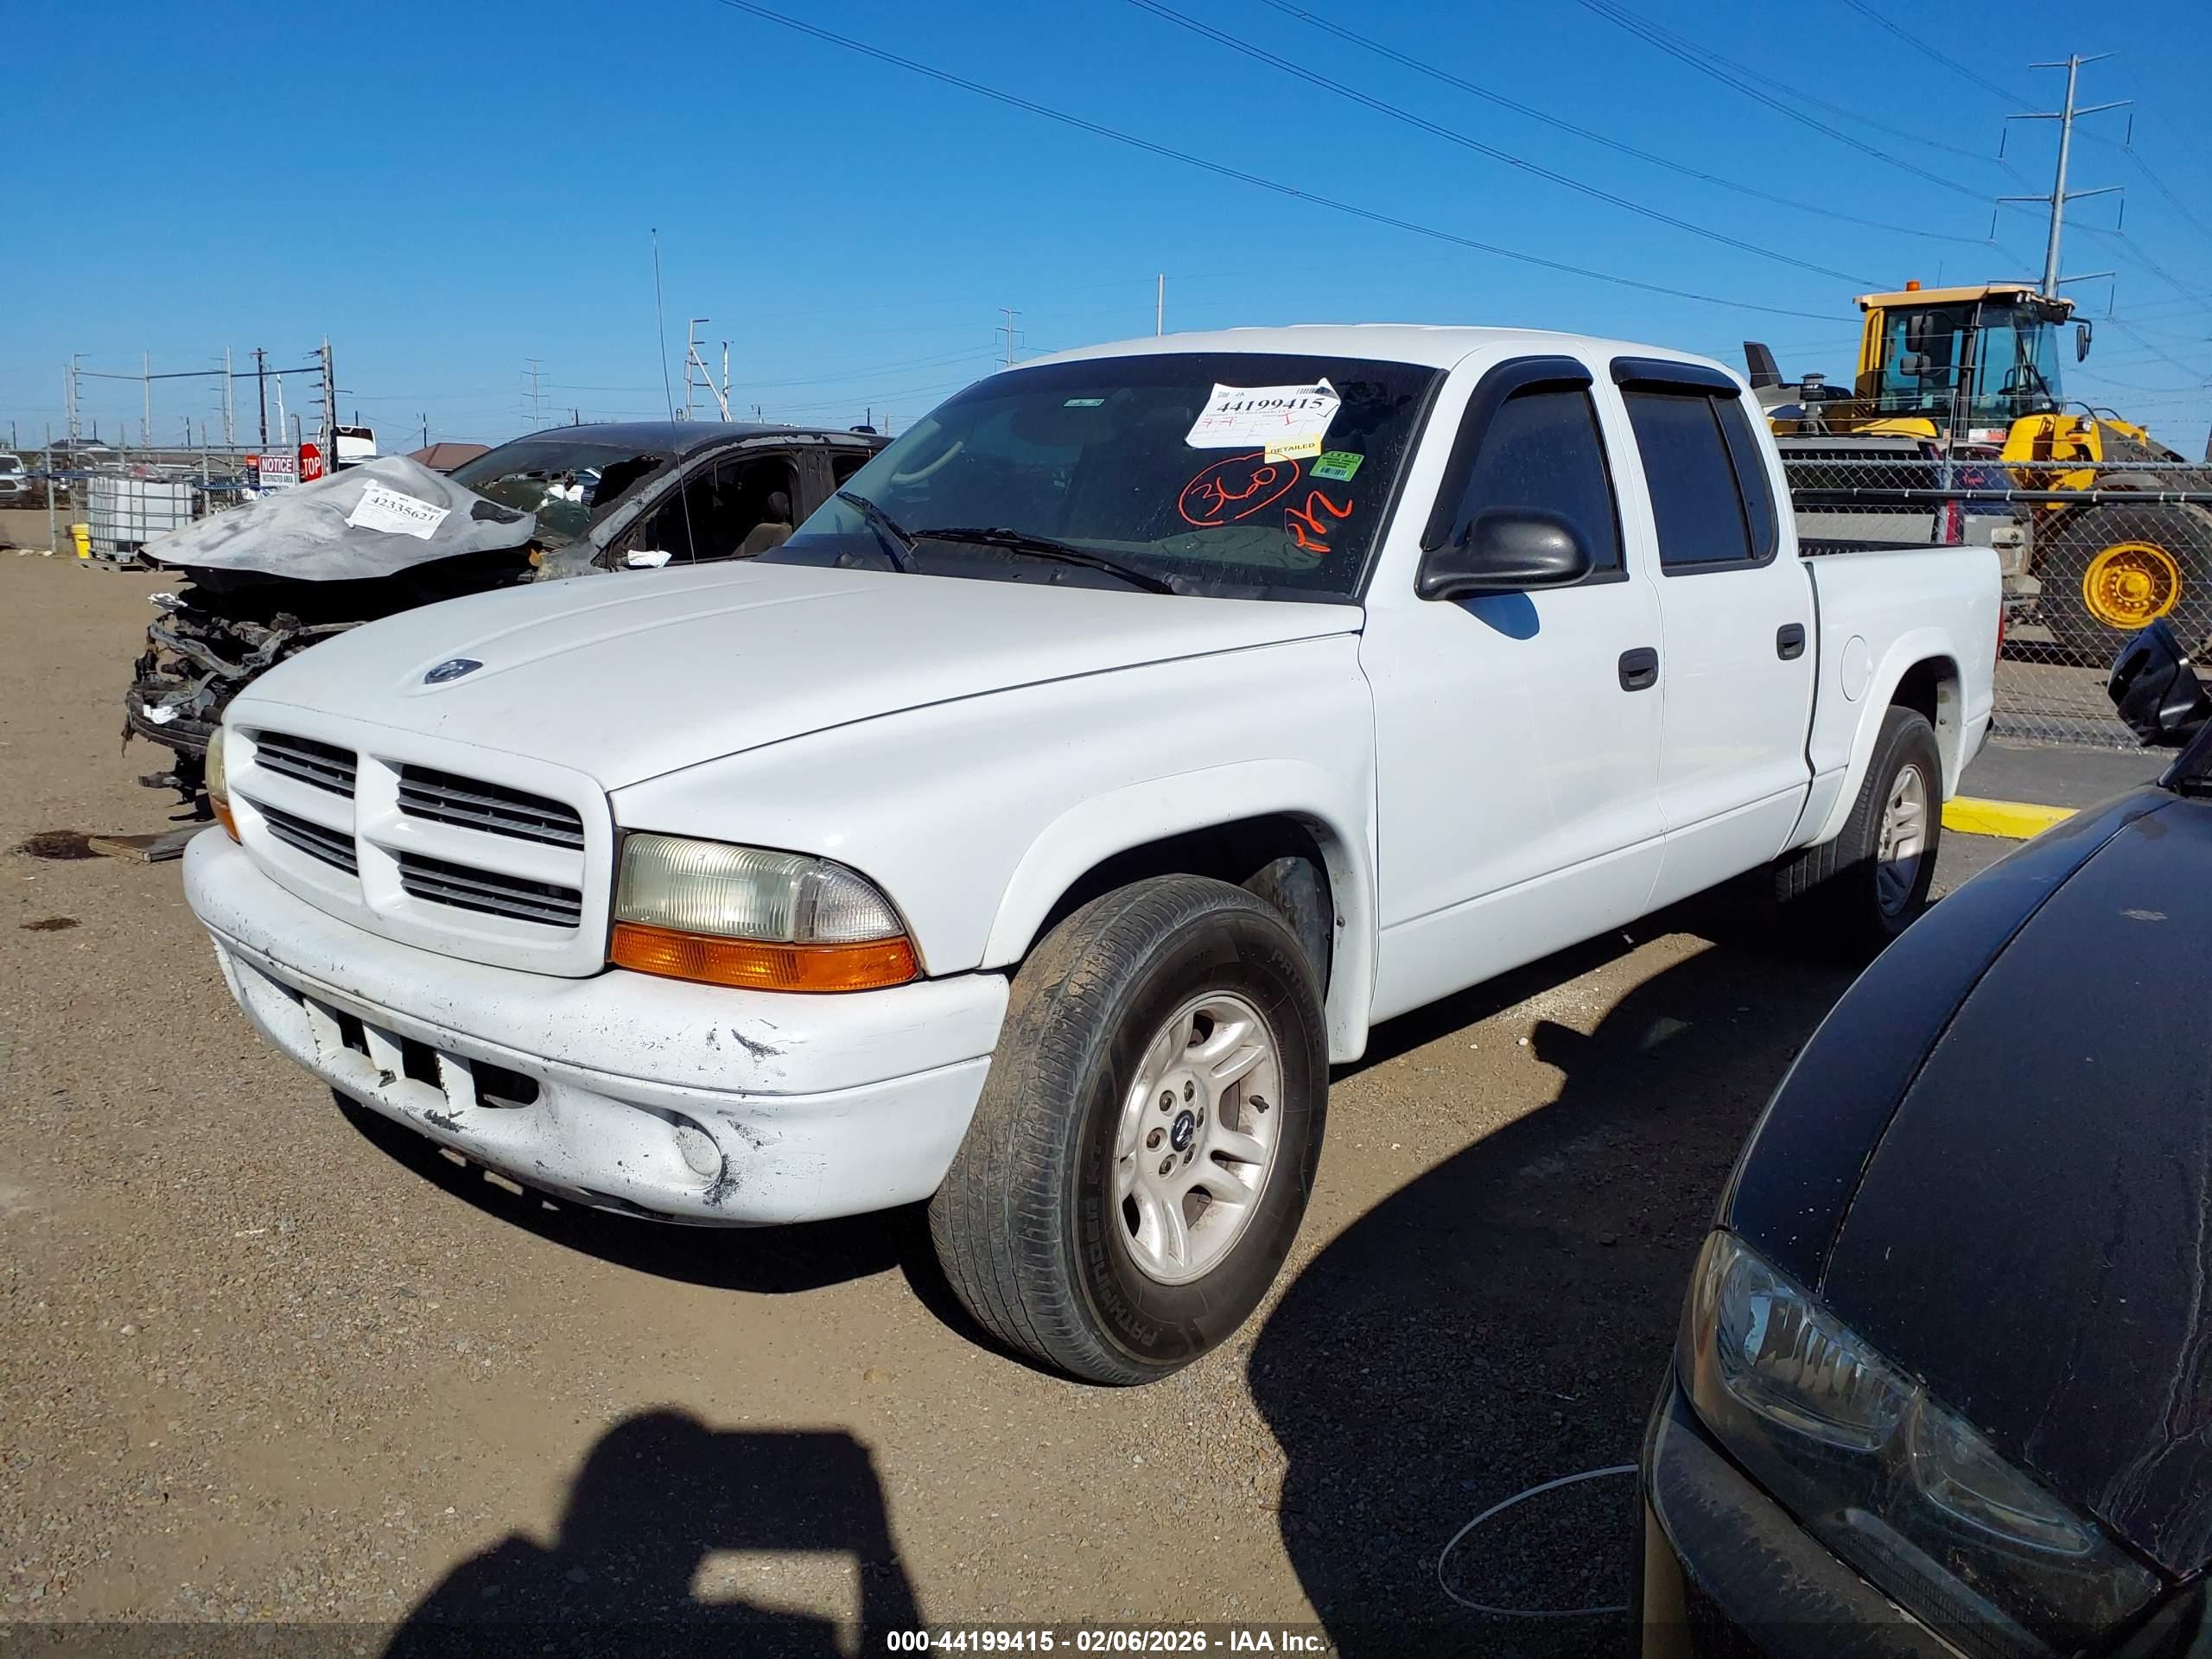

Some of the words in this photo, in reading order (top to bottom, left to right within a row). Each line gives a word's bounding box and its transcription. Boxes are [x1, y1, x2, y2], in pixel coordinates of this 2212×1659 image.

[1217, 397, 1325, 413] 44199415
[1269, 442, 1315, 454] DETAILED
[262, 458, 293, 473] NOTICE
[370, 496, 435, 522] 42335621
